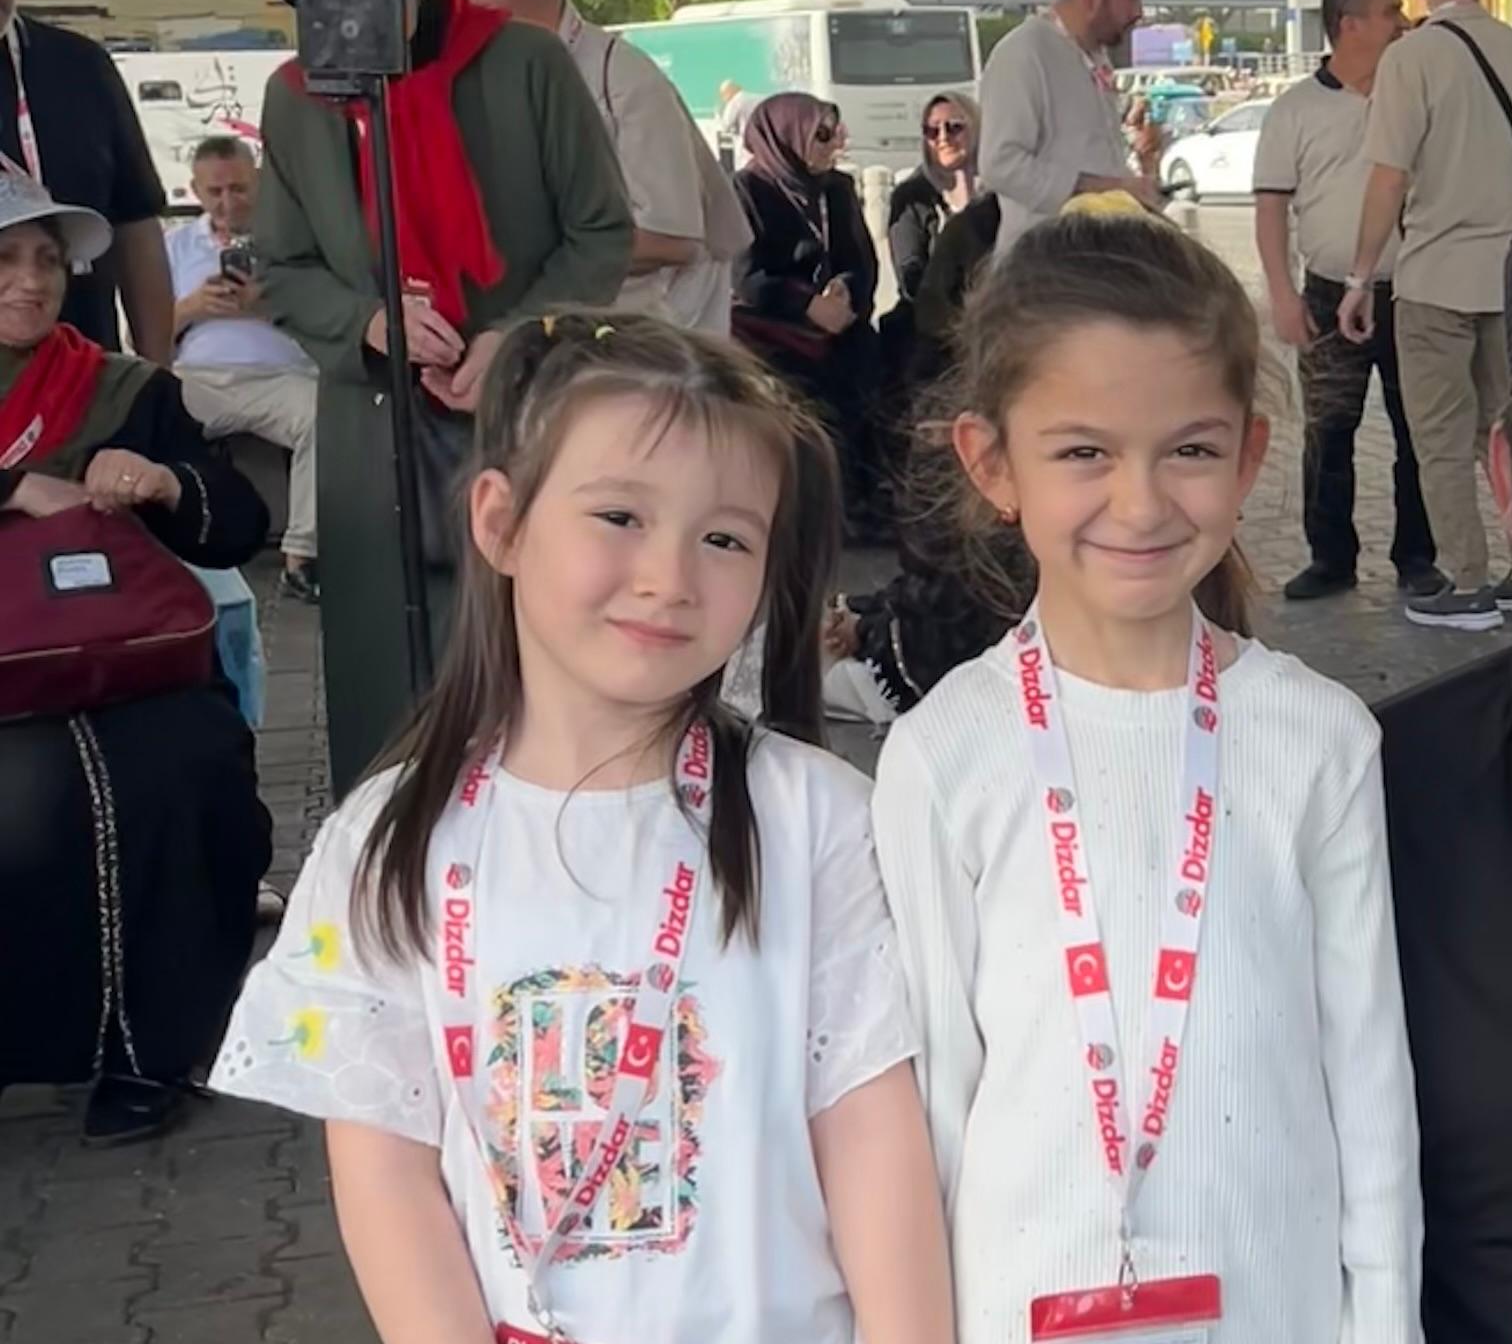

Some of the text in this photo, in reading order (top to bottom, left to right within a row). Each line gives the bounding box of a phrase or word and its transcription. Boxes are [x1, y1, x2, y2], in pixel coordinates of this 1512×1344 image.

[1019, 647, 1052, 730] Dizdar
[1051, 821, 1087, 918] Dizdar
[1182, 787, 1214, 884] Dizdar
[446, 898, 476, 998] Dizdar
[656, 861, 696, 959] Dizdar
[1092, 1078, 1126, 1175] Dizdar
[1142, 1036, 1179, 1137] Dizdar
[576, 1113, 630, 1207] Dizdar
